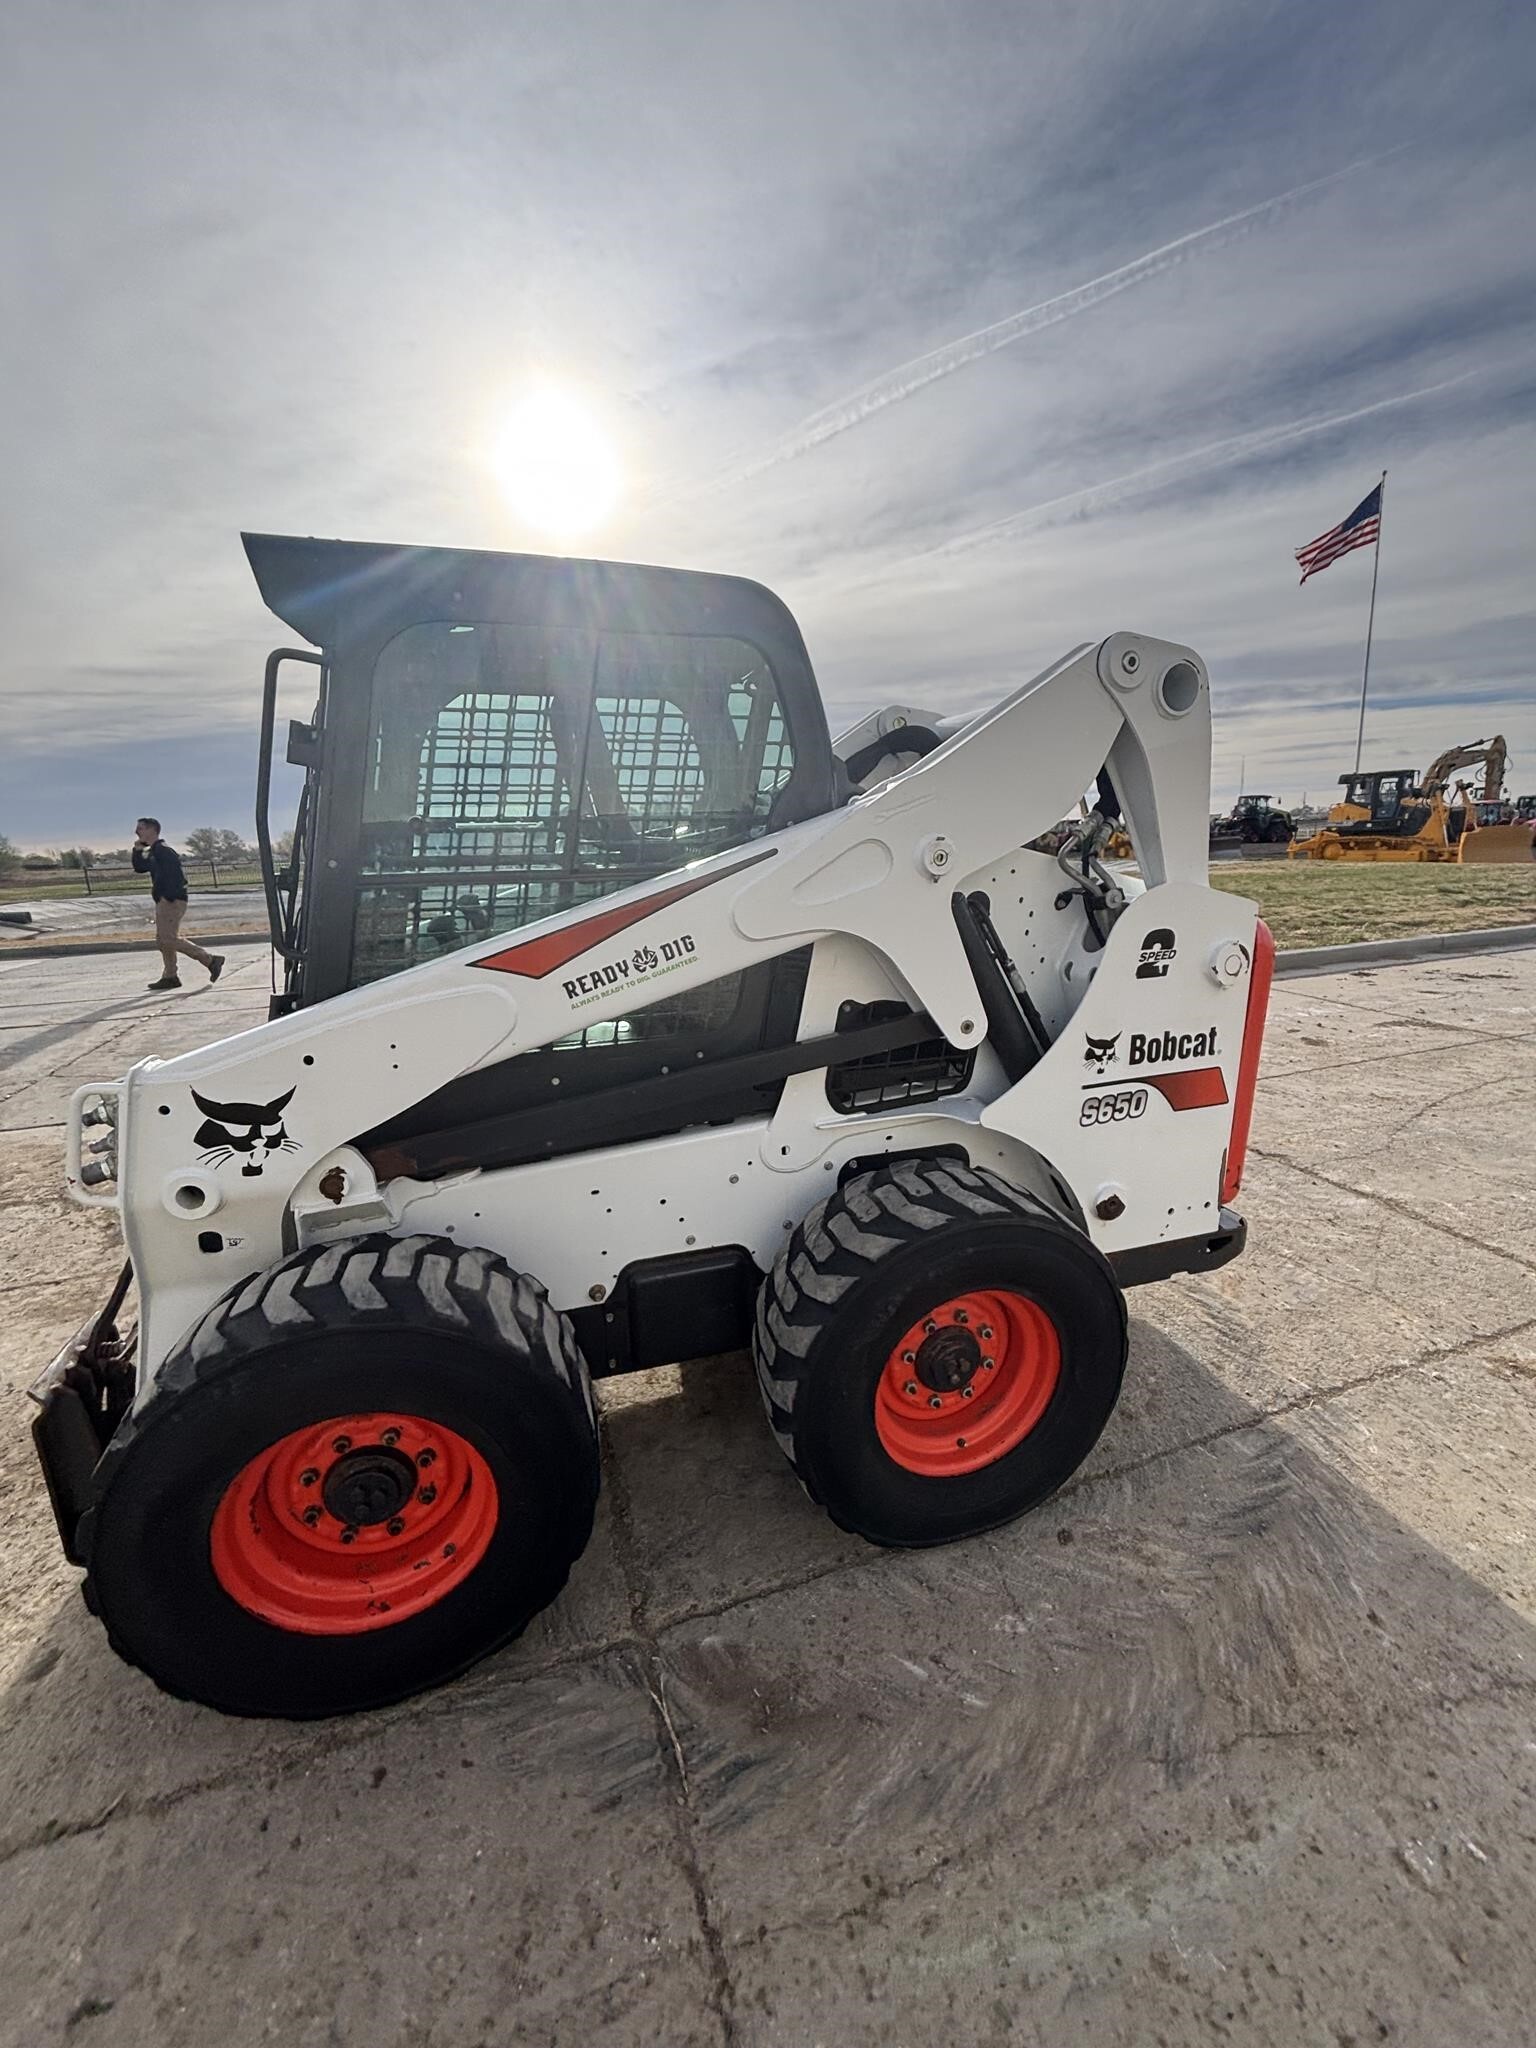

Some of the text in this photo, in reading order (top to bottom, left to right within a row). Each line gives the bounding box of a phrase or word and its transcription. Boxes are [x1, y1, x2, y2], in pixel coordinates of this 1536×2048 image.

[562, 934, 696, 999] READY DIG
[1137, 949, 1177, 963] SPEED
[571, 994, 601, 1010] ALWAYS
[600, 983, 625, 999] READY
[624, 980, 636, 989] TO
[1129, 1026, 1218, 1066] Bobcat
[1079, 1088, 1149, 1128] S650
